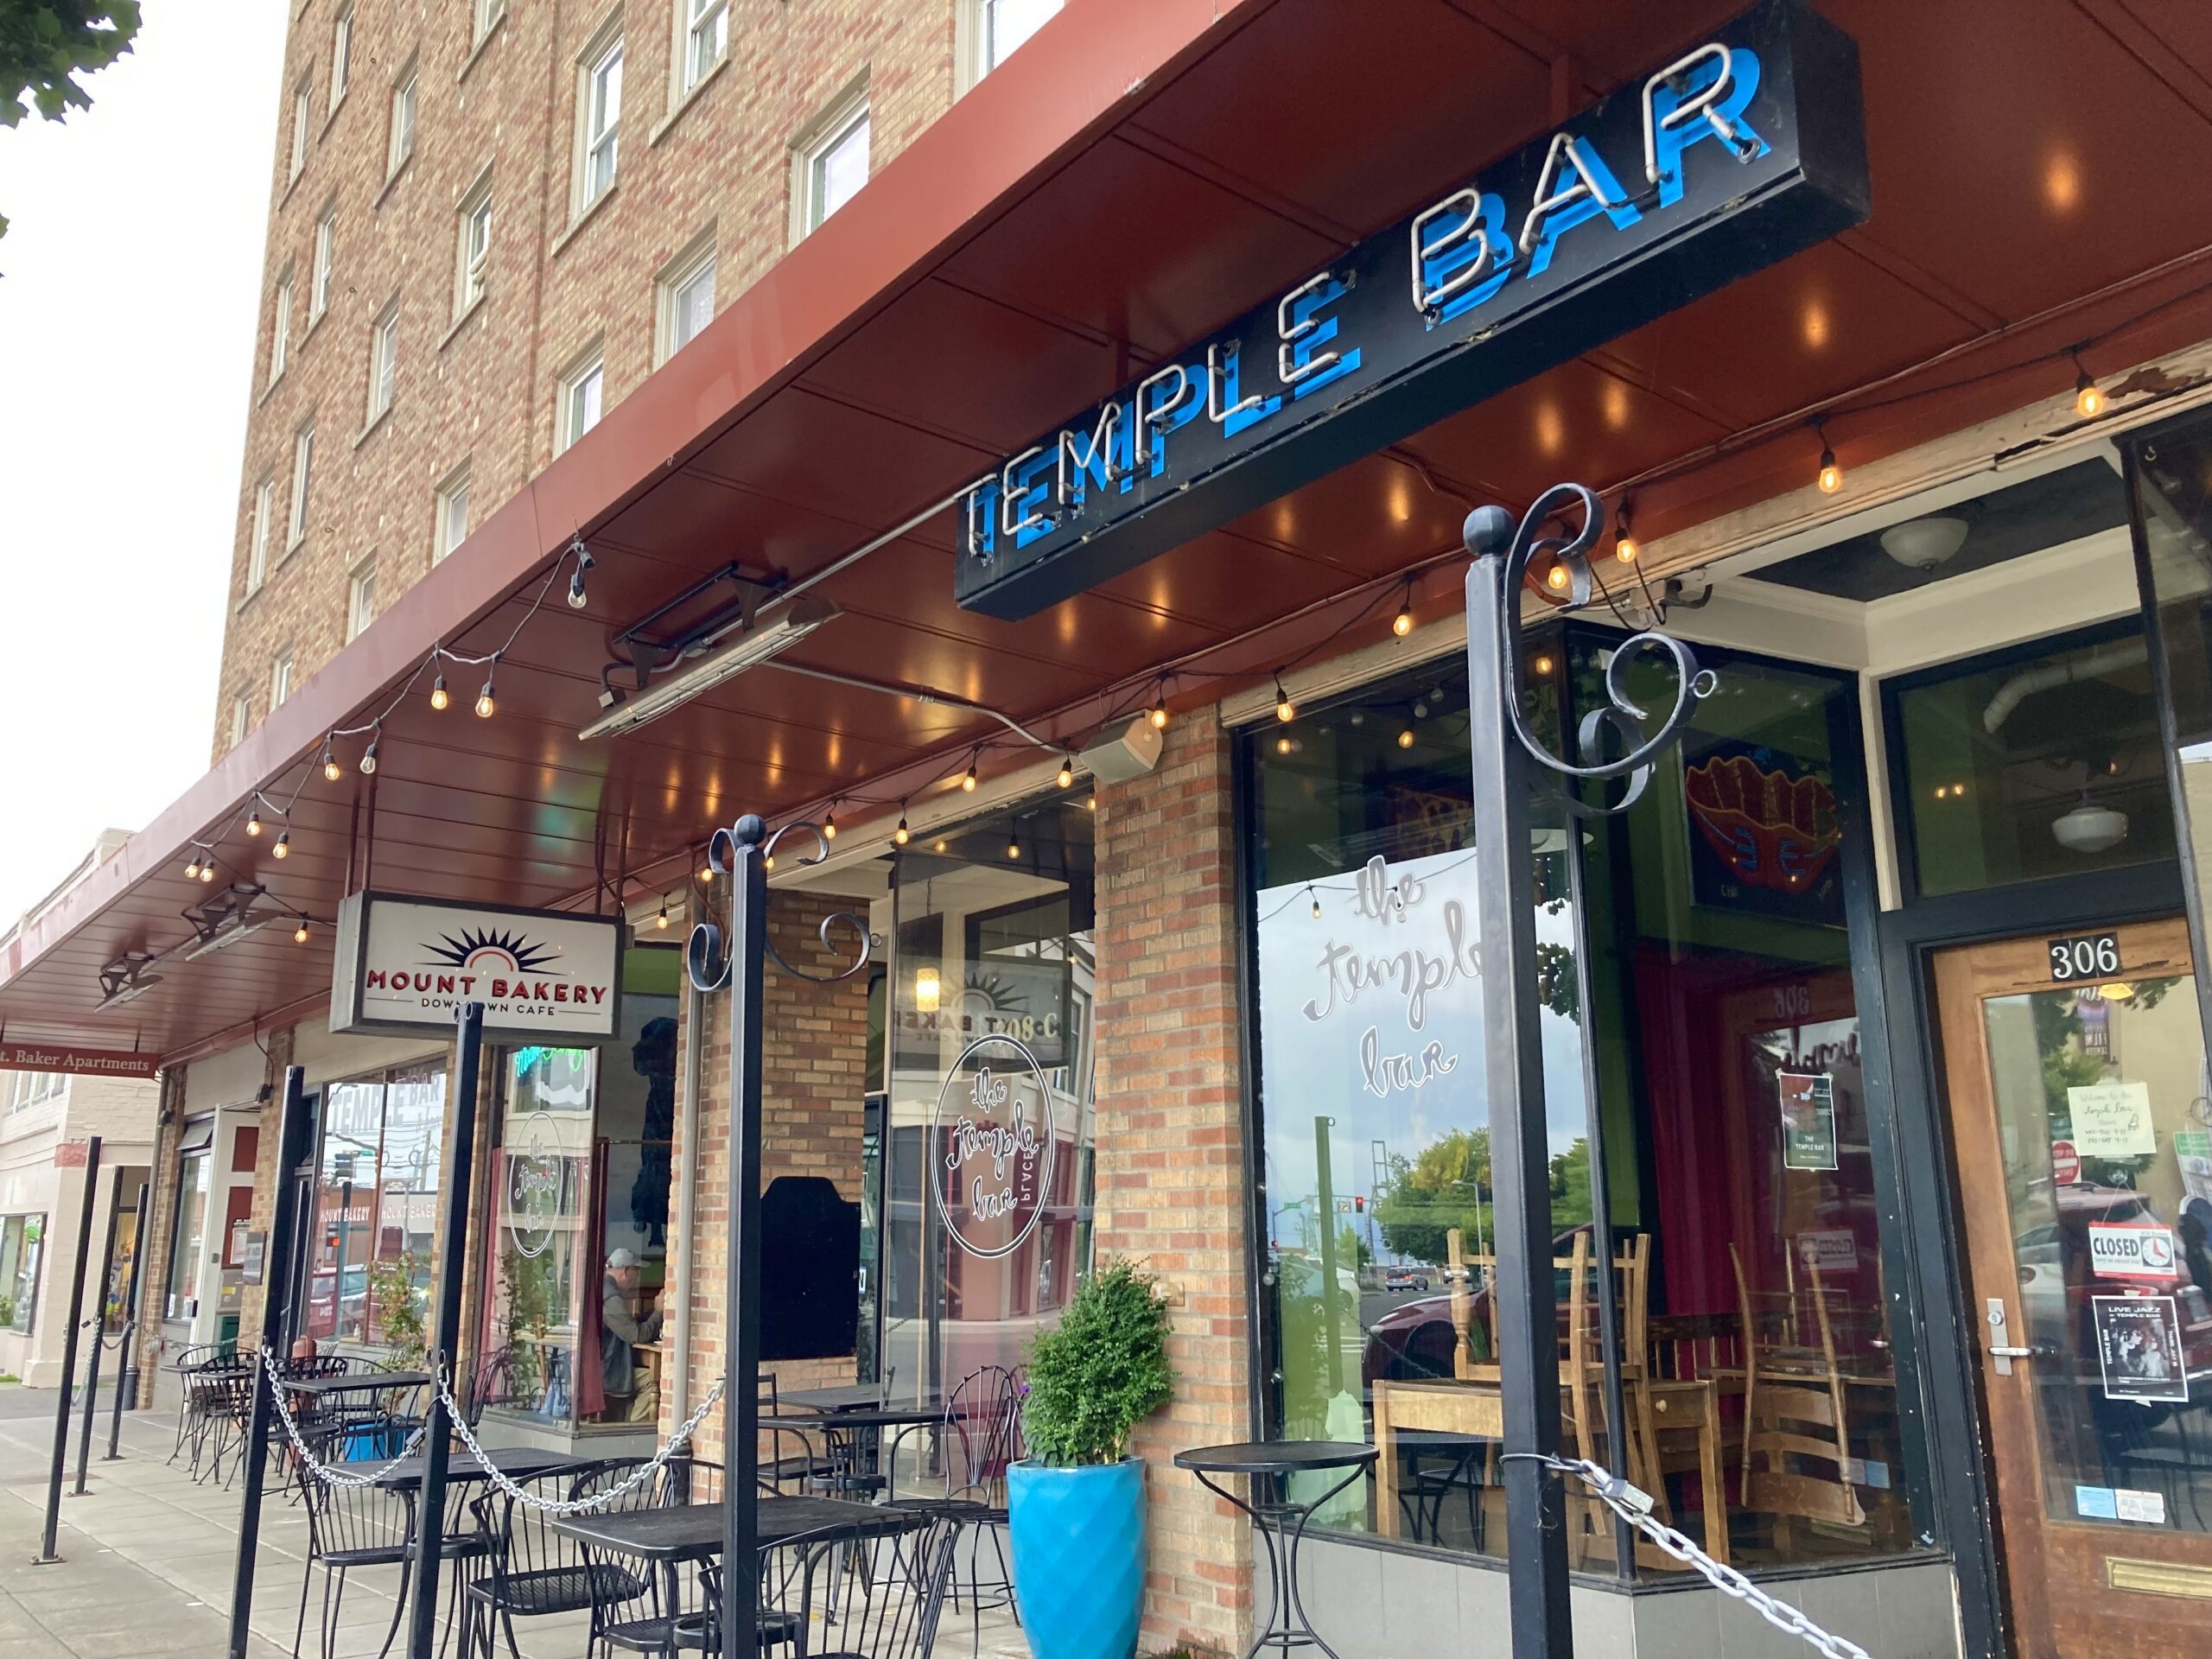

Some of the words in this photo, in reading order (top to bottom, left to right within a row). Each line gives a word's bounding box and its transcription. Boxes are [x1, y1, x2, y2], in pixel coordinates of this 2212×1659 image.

[953, 271, 1362, 567] TEMPLE
[1410, 41, 1773, 332] BAR
[1344, 854, 1427, 927] the
[2050, 938, 2118, 979] 306
[366, 969, 476, 996] MOUNT
[491, 979, 607, 1004] BAKERY
[421, 998, 509, 1013] DOWWN
[516, 1005, 556, 1016] CAFE
[15, 1049, 60, 1065] Baker
[62, 1053, 149, 1071] Apartments
[1360, 1026, 1459, 1097] bar
[332, 1077, 406, 1135] TEMPE
[409, 1070, 441, 1107] BAR
[969, 1067, 1007, 1114] the
[944, 1099, 1039, 1180] temple
[320, 1207, 342, 1223] MOUNT
[343, 1205, 371, 1223] BAKERY
[973, 1174, 1019, 1222] bar
[2093, 1237, 2139, 1256] CLOSED
